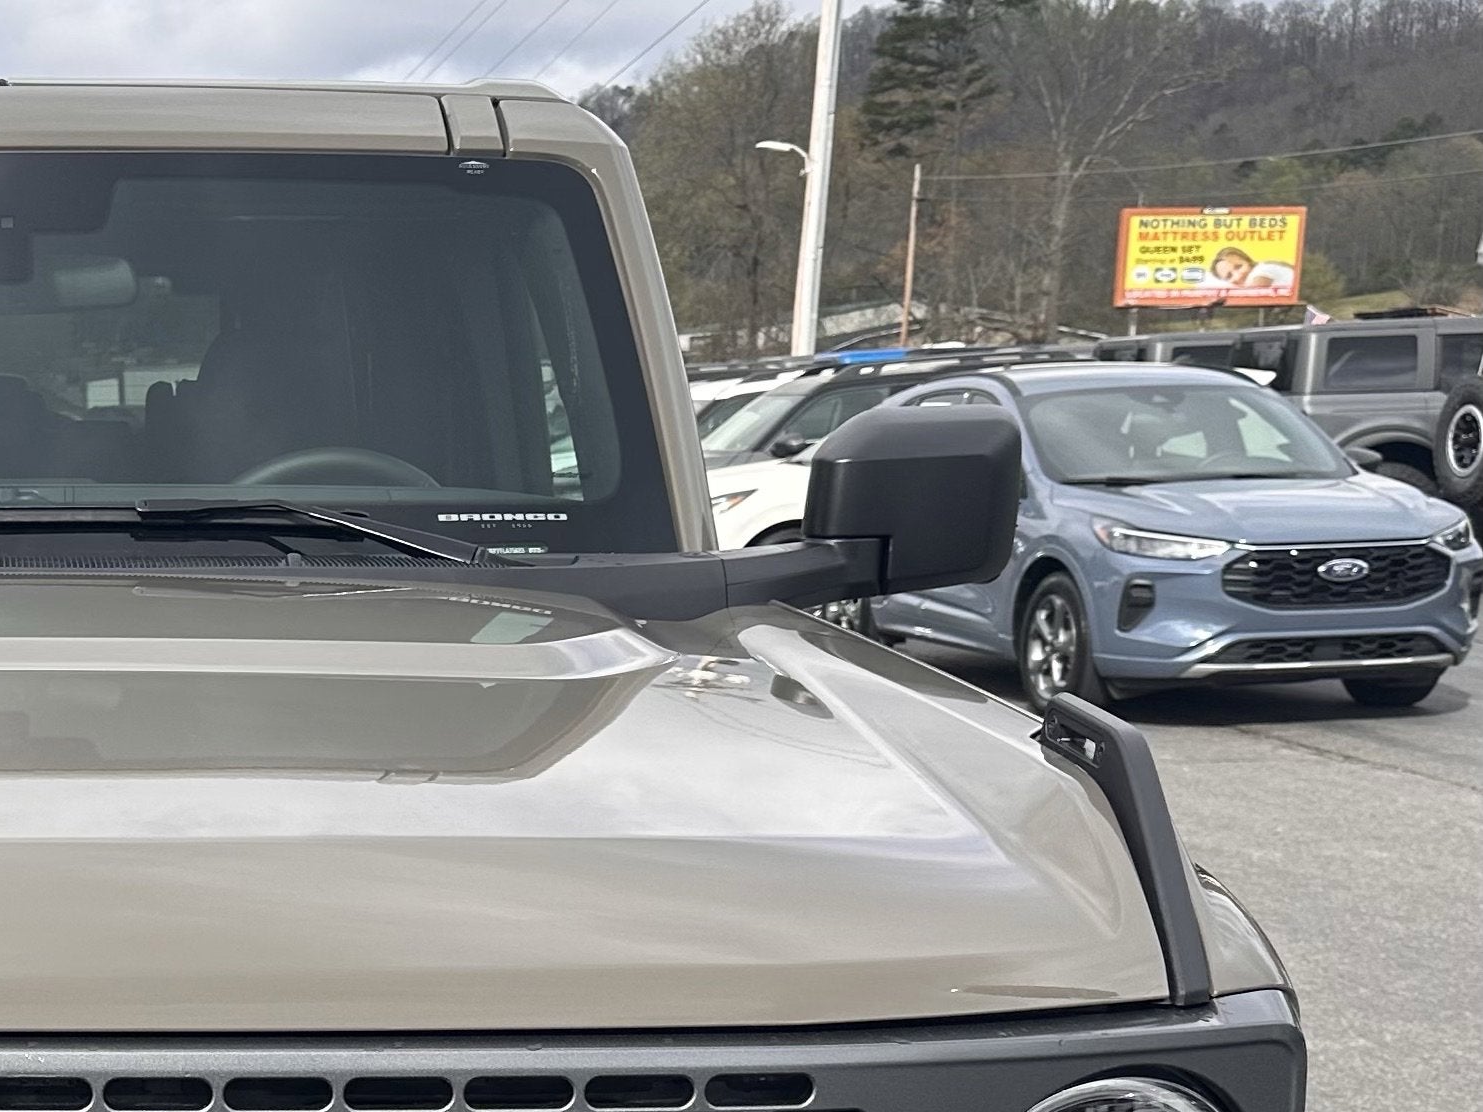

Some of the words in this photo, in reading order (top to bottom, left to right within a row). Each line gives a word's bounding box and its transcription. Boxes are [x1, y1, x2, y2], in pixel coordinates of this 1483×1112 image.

[1138, 218, 1208, 230] NOTHING
[1213, 217, 1243, 229] BUT
[1138, 231, 1220, 241] MATTRESS
[1225, 230, 1286, 241] OUTLET
[437, 513, 568, 522] BRONCO
